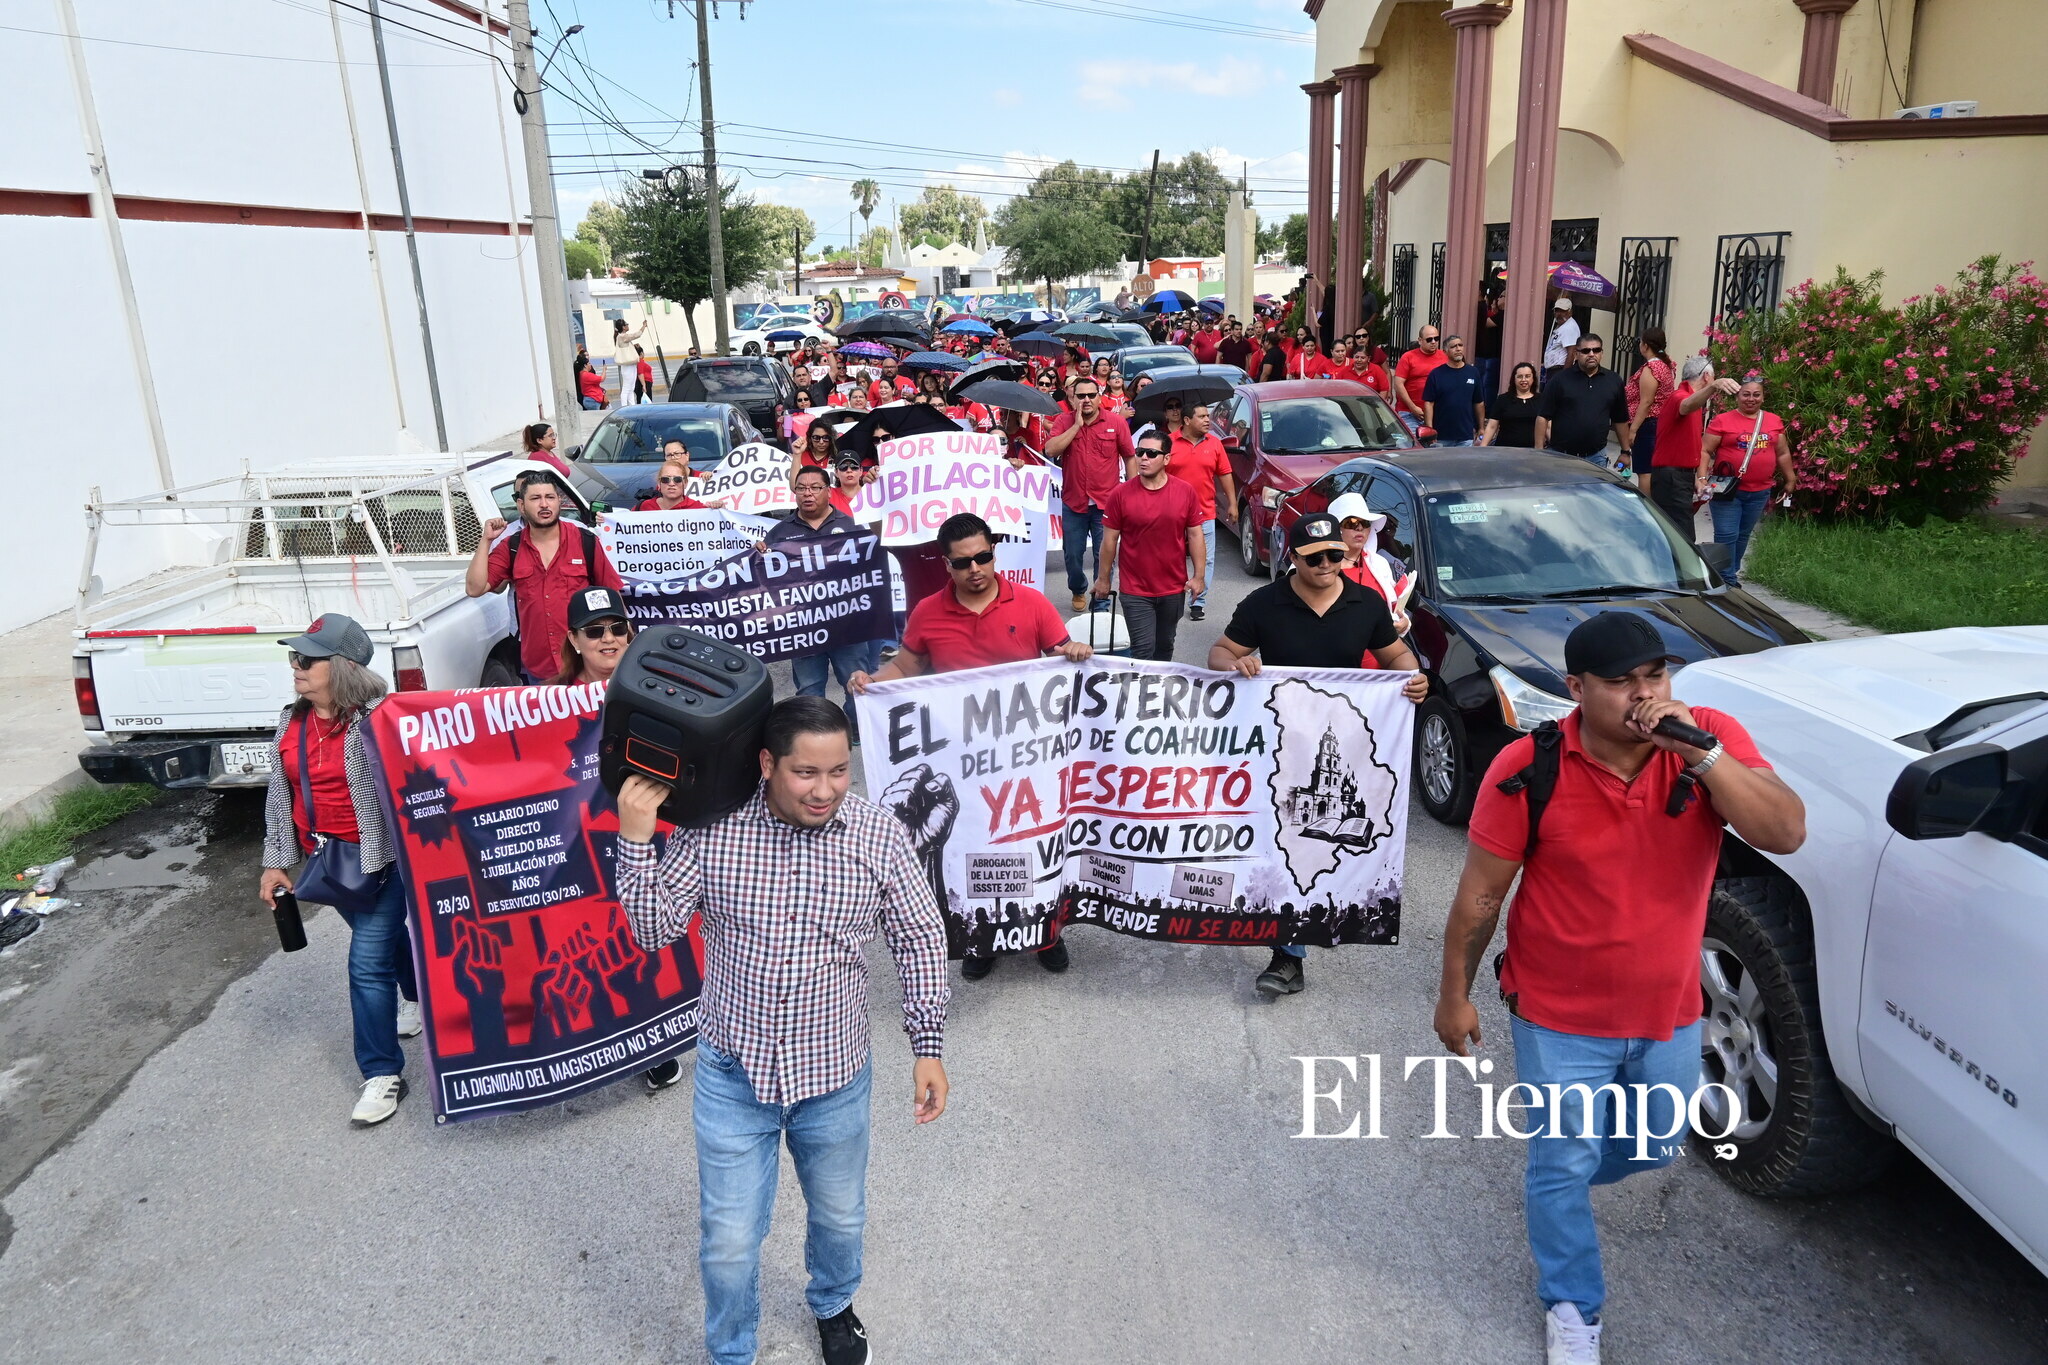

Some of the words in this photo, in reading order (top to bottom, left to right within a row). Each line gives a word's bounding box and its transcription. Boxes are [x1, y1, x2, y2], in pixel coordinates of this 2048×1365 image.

[1133, 281, 1154, 292] ALTO
[1740, 433, 1769, 442] SUER
[879, 436, 935, 466] POR
[946, 435, 999, 455] UNA
[853, 462, 1050, 513] JUBILACION
[614, 520, 673, 536] Aumento
[678, 517, 715, 535] digno
[719, 520, 737, 535] por
[740, 525, 770, 539] arrib
[616, 538, 684, 554] Pensiones
[688, 540, 703, 552] en
[708, 536, 753, 551] salarios
[618, 557, 705, 577] Derogación
[764, 535, 878, 579] D-II-47
[665, 592, 774, 619] RESPUESTA
[779, 569, 884, 608] FAVORABLE
[744, 618, 769, 638] DE
[773, 594, 872, 632] DEMANDAS
[115, 717, 163, 726] NP300
[399, 702, 476, 756] PARO
[483, 678, 610, 736] NACIONA
[887, 700, 951, 766] EL
[962, 669, 1236, 746] MAGISTERIO
[239, 744, 267, 752] COAHUILA
[960, 750, 1004, 780] DEL
[1089, 729, 1116, 753] DE
[1124, 724, 1267, 757] COAHUILA
[224, 751, 272, 766] EZ-1153
[584, 752, 600, 765] DES
[582, 770, 593, 780] DE
[405, 796, 411, 805] 4
[411, 788, 446, 804] ESCUELAS
[413, 804, 447, 820] SEGURAS,
[473, 816, 478, 827] 1
[479, 806, 524, 825] SALARIO
[525, 799, 559, 815] DIGNO
[979, 777, 1044, 838] YA
[496, 821, 541, 840] DIRECTO
[480, 849, 494, 862] AL
[494, 840, 535, 859] SUELDO
[537, 834, 564, 850] BASE.
[605, 847, 615, 857] 3.
[1036, 819, 1102, 869] VAOS
[1109, 822, 1169, 856] CON
[1178, 824, 1255, 854] TODO
[481, 868, 488, 879] 2
[488, 855, 546, 878] JUBILACIÓN
[547, 851, 567, 866] POR
[972, 857, 1026, 868] ABROGACION
[1089, 855, 1127, 875] SALARIOS
[511, 875, 541, 892] AÑOS
[971, 870, 982, 880] DE
[984, 870, 994, 880] LA
[995, 870, 1010, 880] LEY
[1013, 870, 1029, 880] DEL
[1092, 868, 1121, 885] DIGNOS
[1183, 871, 1196, 883] NO
[1198, 874, 1205, 884] A
[1207, 875, 1224, 886] LAS
[973, 882, 1003, 893] ISSSTE
[1004, 882, 1027, 893] 2007
[1189, 886, 1216, 898] UMAS
[437, 895, 471, 915] 28/30
[487, 900, 499, 913] DE
[499, 894, 541, 912] SERVICIO
[541, 883, 585, 907] (30/28).
[992, 916, 1044, 952] AQUÍ
[1075, 898, 1098, 919] SE
[1104, 903, 1161, 934] VENDE
[1168, 917, 1193, 937] NI
[1197, 918, 1225, 938] SE
[1229, 920, 1279, 940] RAJA
[453, 1079, 470, 1100] LA
[471, 1068, 525, 1099] DIGNIDAD
[527, 1067, 550, 1089] DEL
[549, 1042, 626, 1083] MAGISTERIO
[630, 1032, 648, 1055] NO
[649, 1024, 664, 1046] SE
[1883, 998, 2019, 1110] SILVERADO
